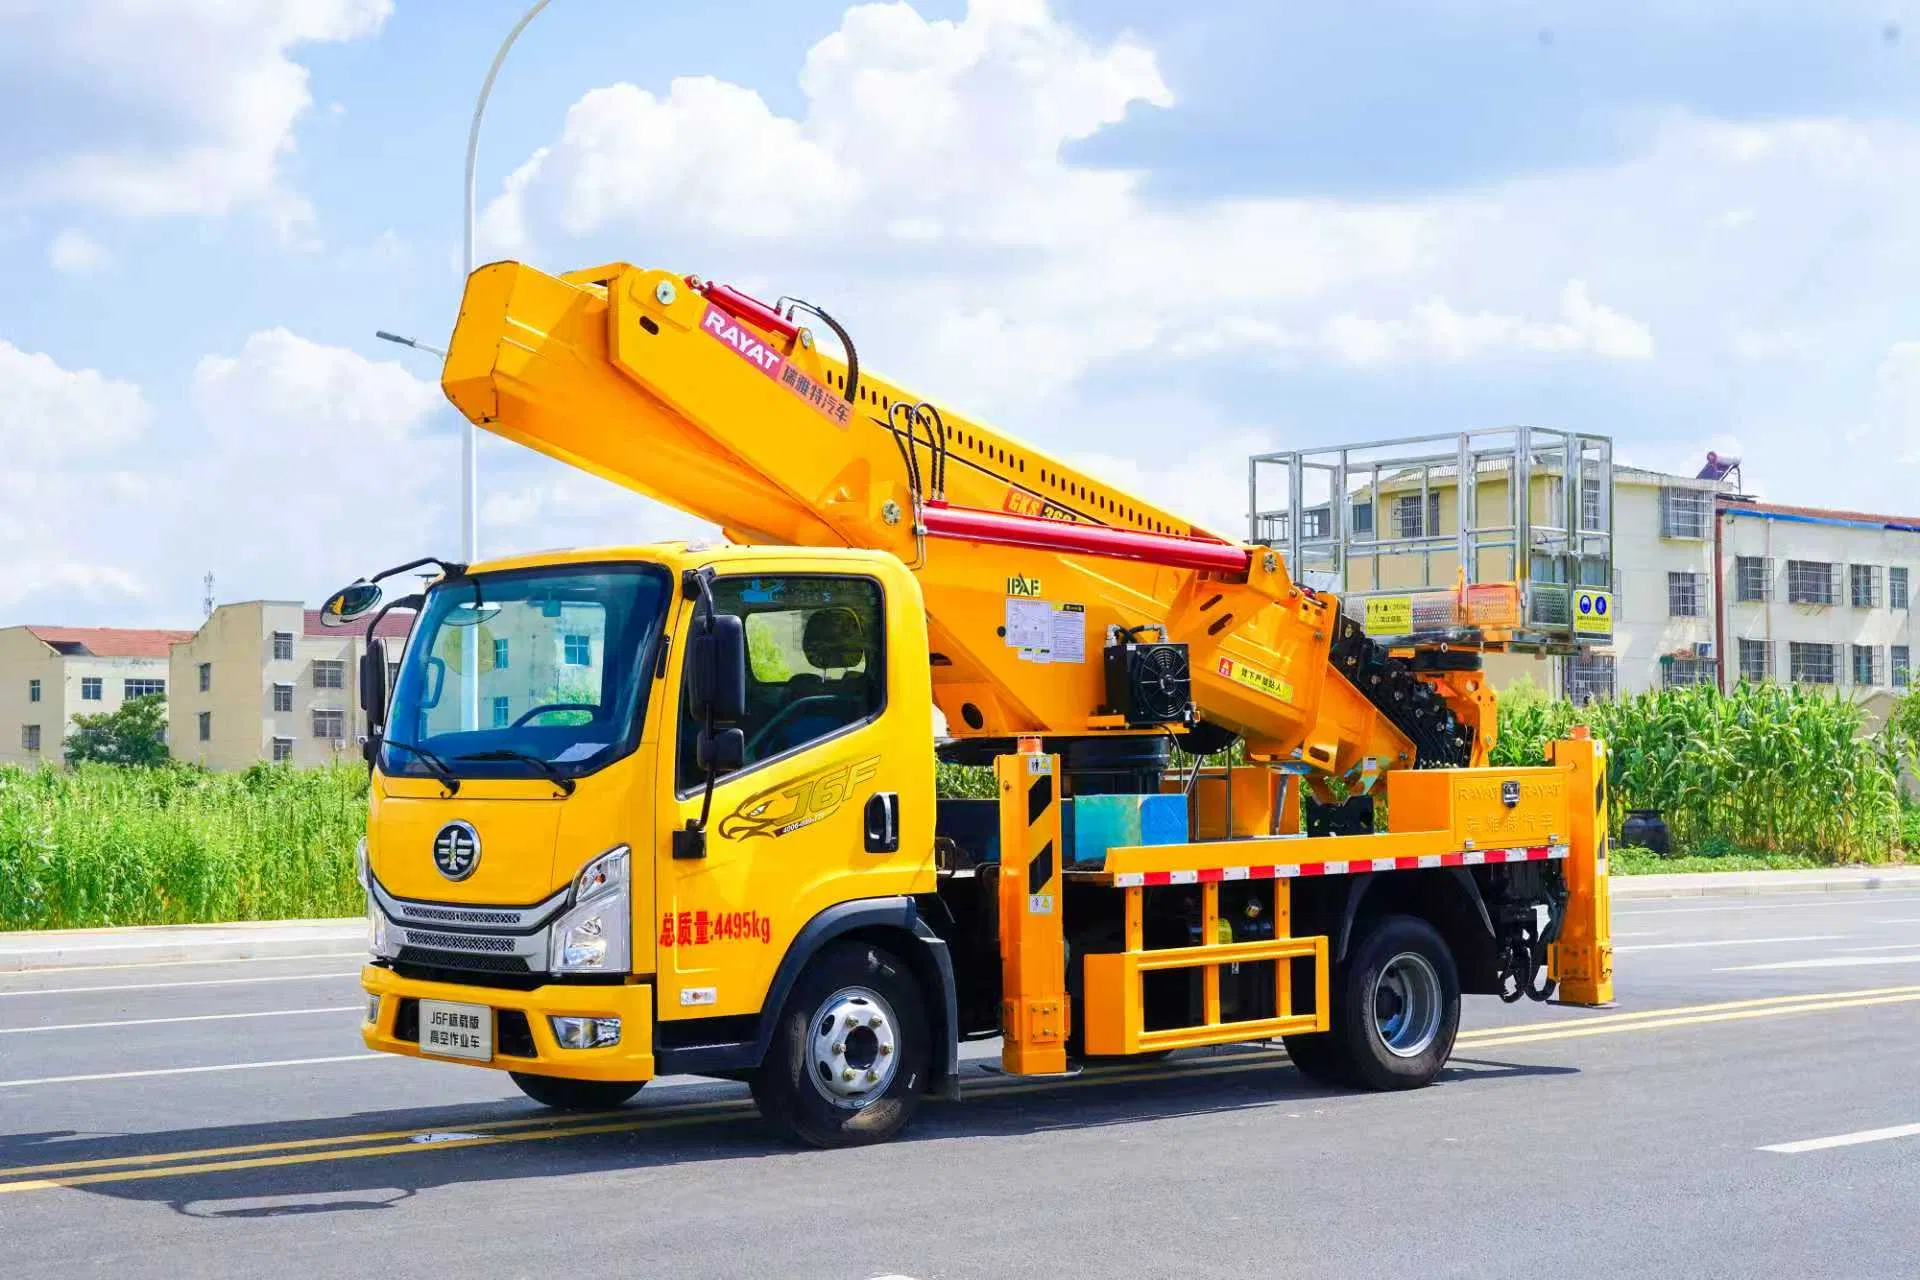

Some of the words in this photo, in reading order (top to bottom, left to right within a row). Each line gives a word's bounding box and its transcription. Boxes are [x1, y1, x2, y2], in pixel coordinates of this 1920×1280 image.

[704, 311, 780, 369] RAYAT
[782, 366, 849, 422] 瑞雅特汽车
[1008, 491, 1040, 516] GKS
[1007, 573, 1039, 596] IPAF
[773, 754, 881, 827] J6F
[430, 1030, 480, 1049] 高空作业车
